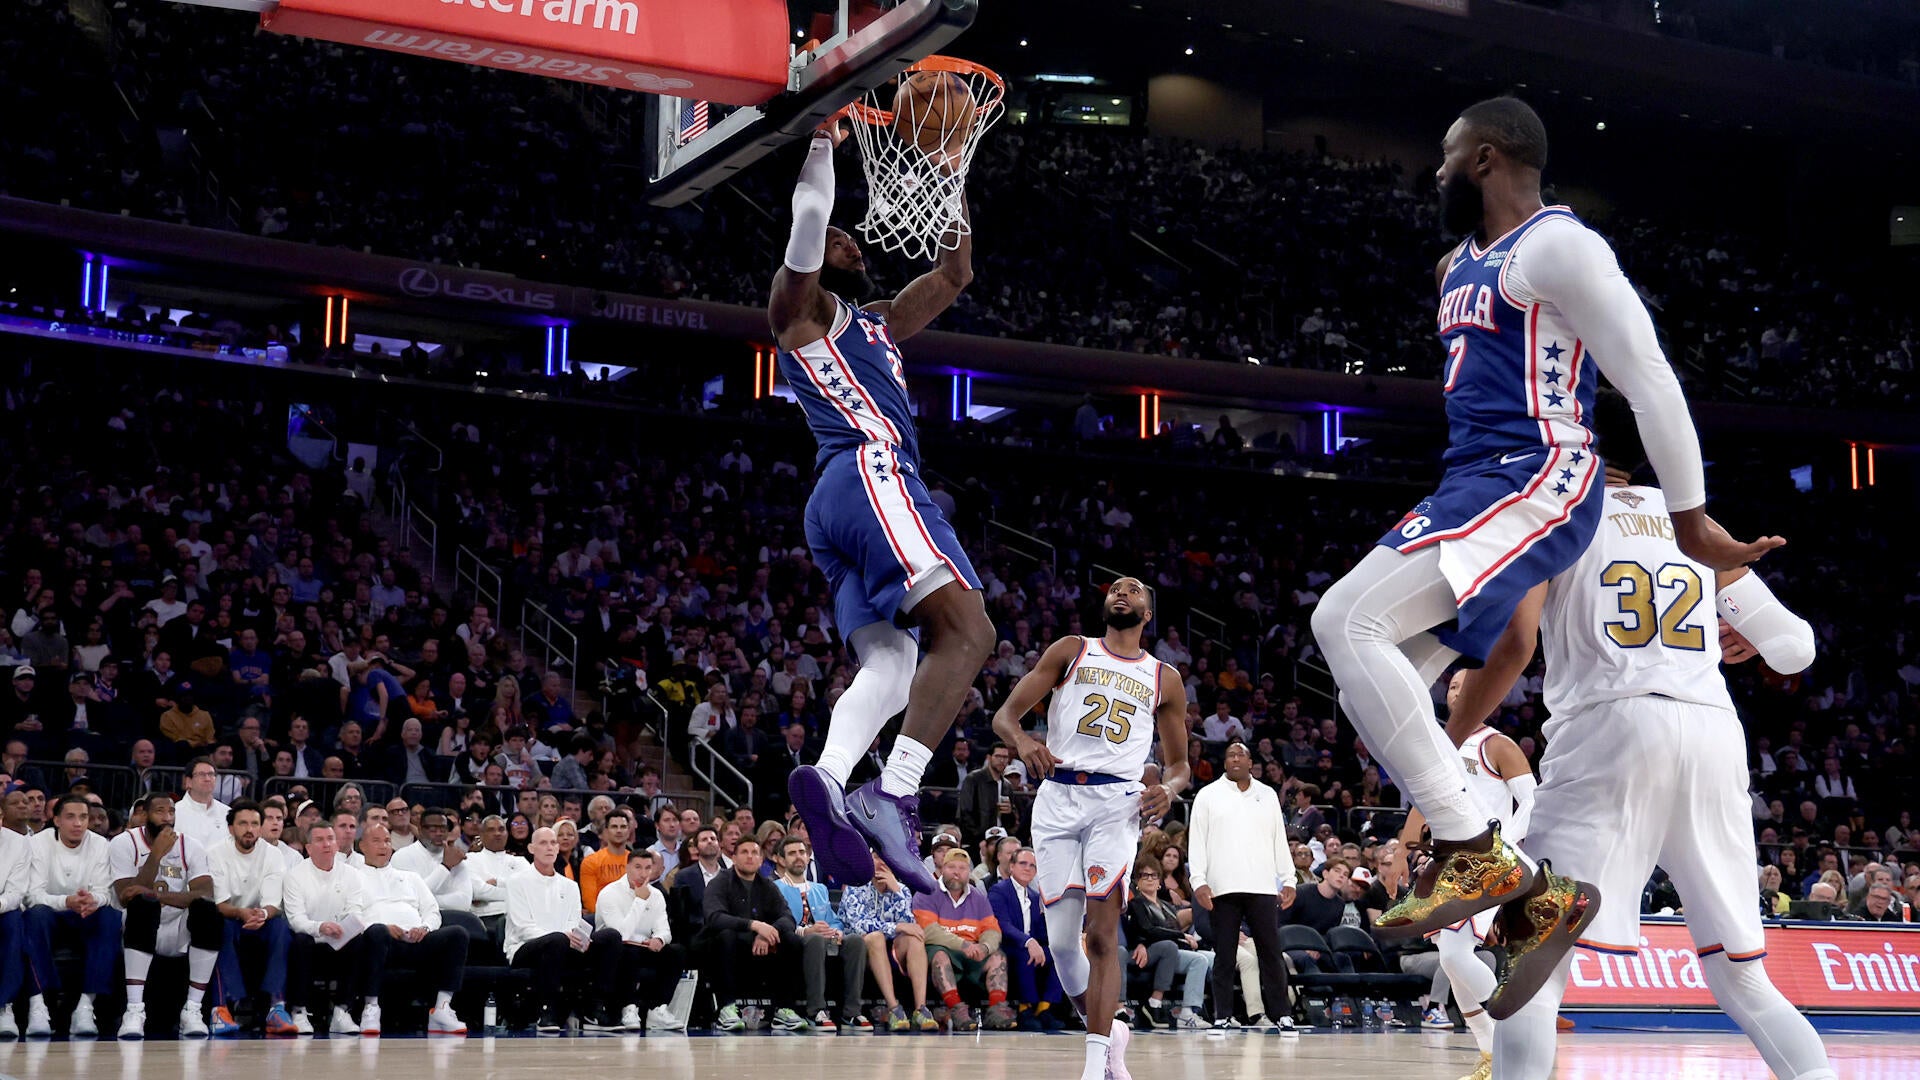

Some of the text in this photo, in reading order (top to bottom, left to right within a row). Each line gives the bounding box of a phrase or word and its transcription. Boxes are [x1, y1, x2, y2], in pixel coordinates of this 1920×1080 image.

[363, 29, 622, 82] StateFarm
[443, 278, 555, 310] LEXUS
[652, 306, 709, 330] LEVEL
[1444, 334, 1467, 392] 7
[1608, 512, 1675, 542] TOWNS
[1600, 560, 1706, 652] 32
[1075, 666, 1114, 687] NEW
[1115, 671, 1154, 707] YORK
[1076, 692, 1137, 745] 25
